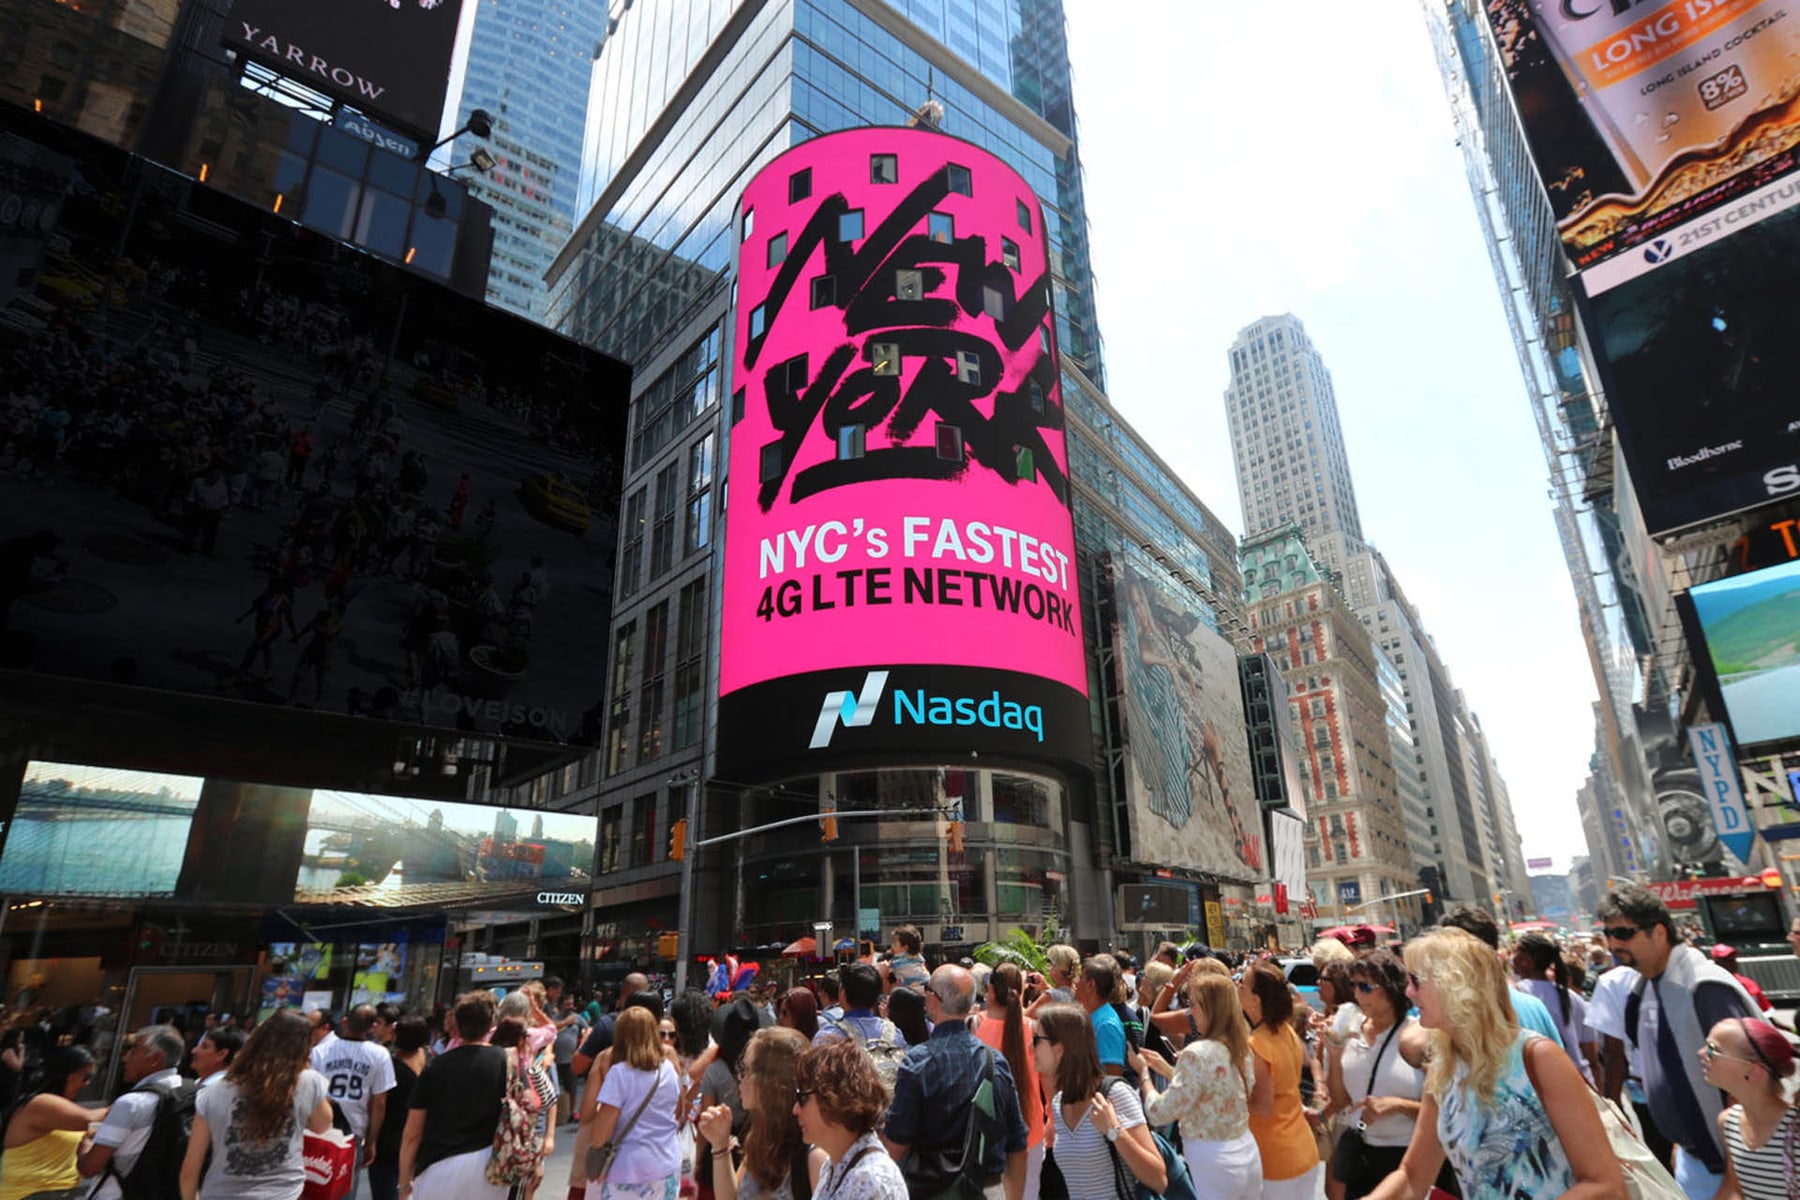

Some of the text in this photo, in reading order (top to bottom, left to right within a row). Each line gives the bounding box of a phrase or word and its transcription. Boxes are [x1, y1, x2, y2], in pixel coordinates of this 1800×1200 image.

[241, 21, 386, 100] YARROW
[1592, 12, 1680, 71] LONG
[1640, 72, 1676, 96] LONG
[1677, 48, 1721, 79] ISLAND
[1725, 10, 1788, 51] COCKTAIL
[1701, 69, 1742, 100] 8%
[1679, 218, 1722, 246] 21ST
[760, 517, 1069, 591] NYC's FASTEST
[756, 568, 1075, 636] 4G LTE NETWORK
[894, 690, 1043, 742] Nasdaq
[1698, 729, 1739, 829] NYPD
[537, 891, 584, 905] CITIZEN
[160, 942, 239, 957] CITIZEN
[328, 1073, 363, 1100] 69
